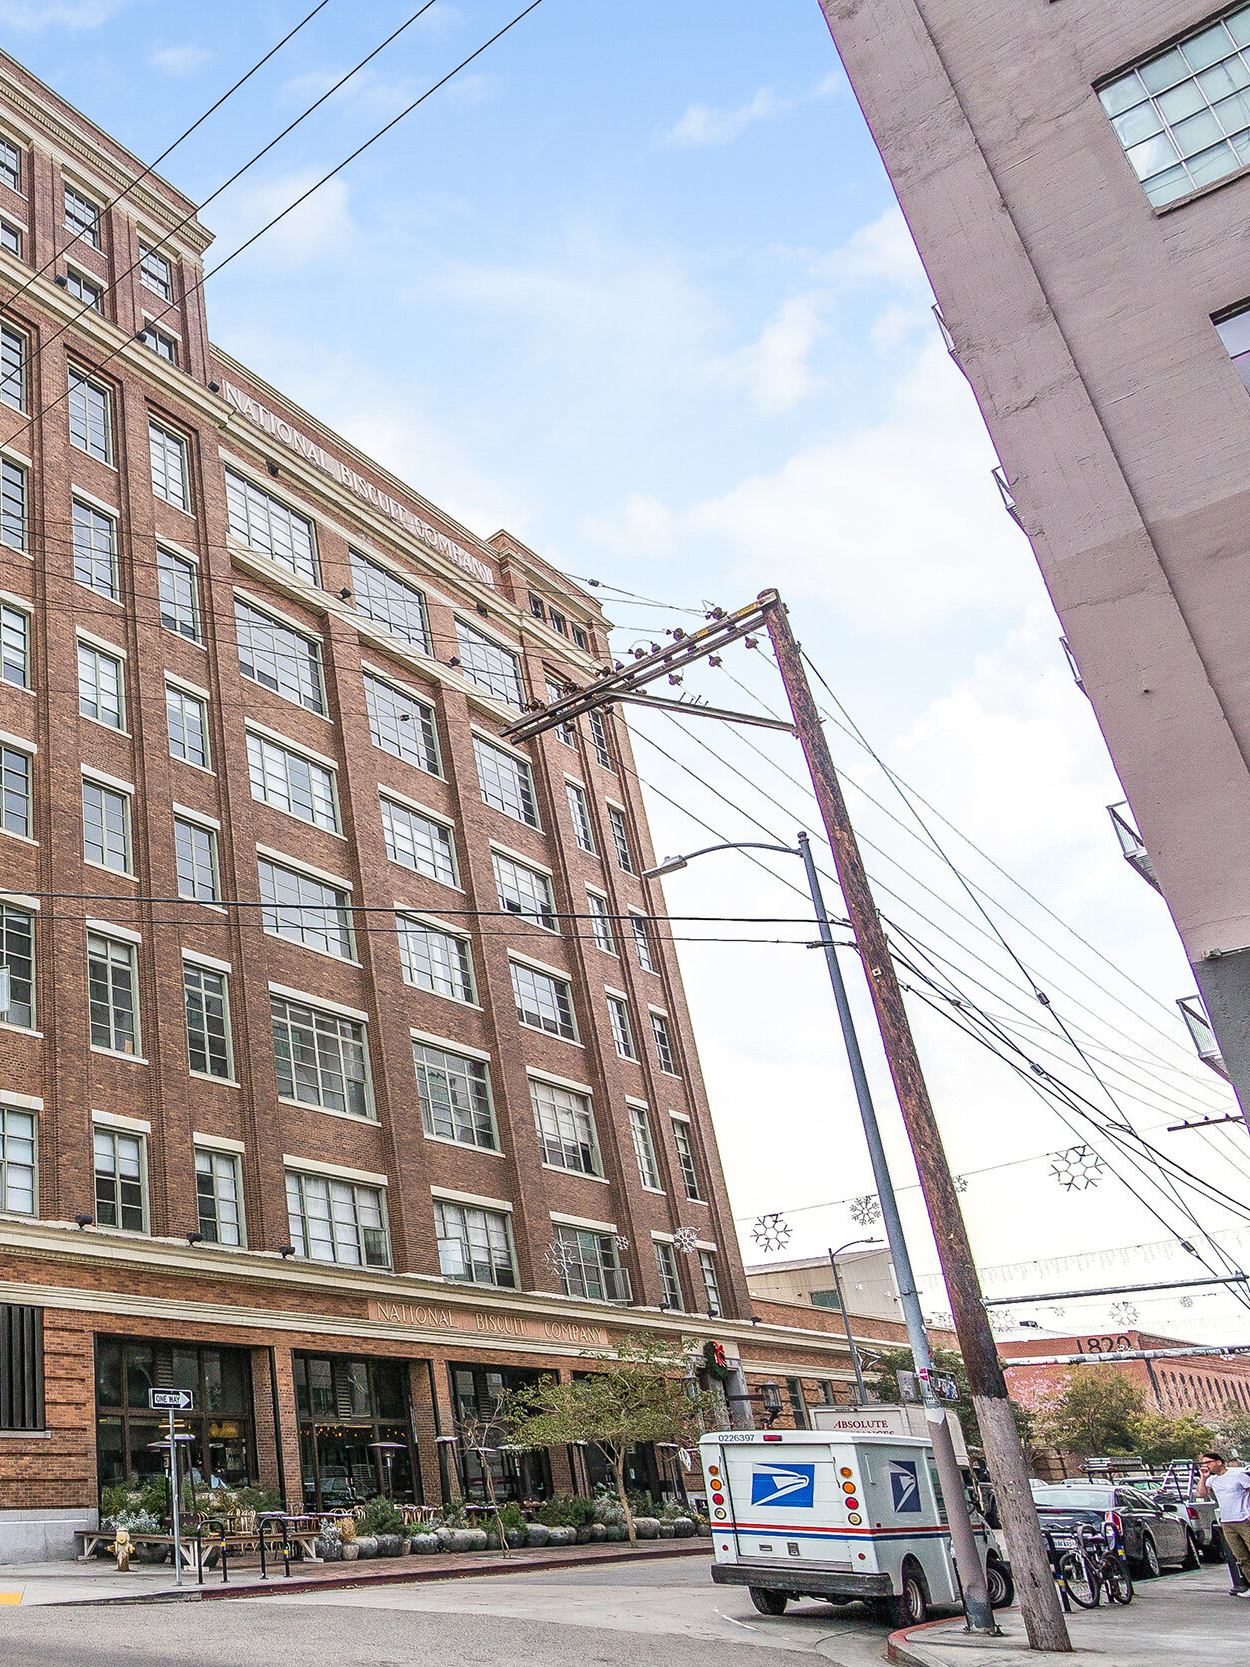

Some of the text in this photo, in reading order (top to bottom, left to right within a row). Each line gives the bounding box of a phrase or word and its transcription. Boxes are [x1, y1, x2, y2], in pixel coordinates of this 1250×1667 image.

[222, 378, 496, 592] NATIONAL BISCUIT COMPANY
[376, 1301, 602, 1343] NATIONAL BISCUIT COMPANY
[1076, 1335, 1132, 1354] 1820
[155, 1395, 180, 1404] ONE WAY
[833, 1420, 889, 1429] ABSOLUTE
[718, 1434, 755, 1442] 0226397
